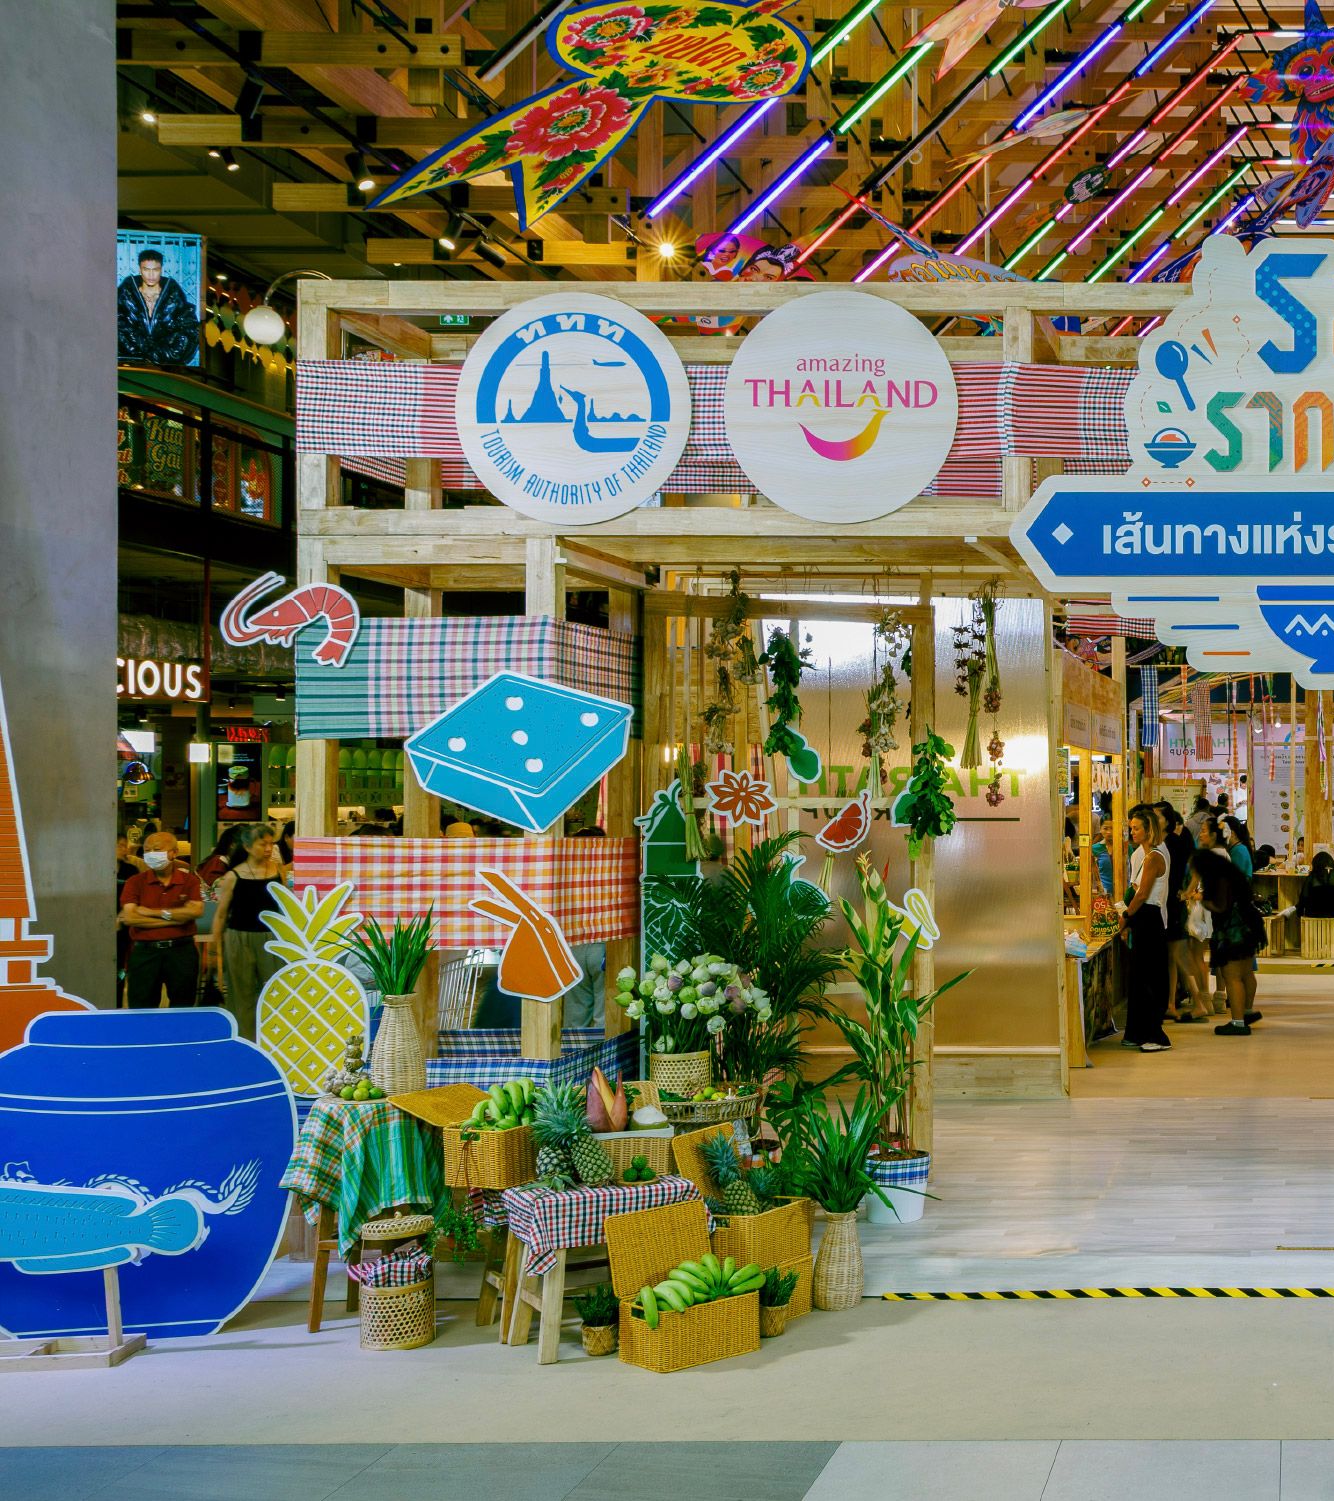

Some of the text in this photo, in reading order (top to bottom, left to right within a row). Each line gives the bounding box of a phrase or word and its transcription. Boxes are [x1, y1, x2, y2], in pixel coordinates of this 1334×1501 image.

[515, 313, 626, 345] ททท
[796, 353, 885, 377] amazing
[744, 378, 938, 409] THAILAND
[480, 423, 668, 506] TOURISM AUTHORITY OF THAILAND
